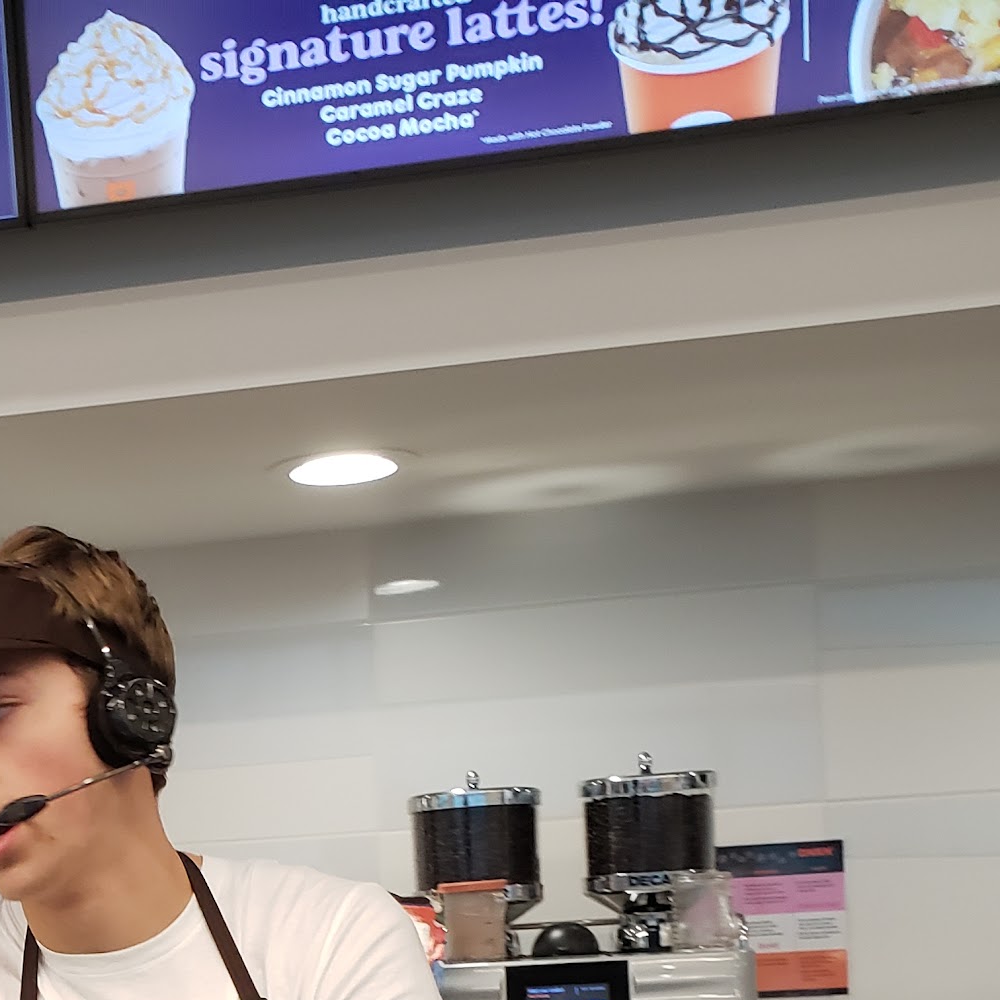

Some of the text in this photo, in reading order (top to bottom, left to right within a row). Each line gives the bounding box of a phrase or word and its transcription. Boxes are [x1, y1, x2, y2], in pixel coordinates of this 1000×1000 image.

[319, 0, 473, 25] handcra
[200, 0, 605, 87] signature lattes!
[261, 51, 544, 108] Cinnamon Sugar Pumpkin
[319, 87, 484, 123] Caramel Craze
[325, 122, 397, 147] Cocoa
[629, 874, 672, 886] DECA
